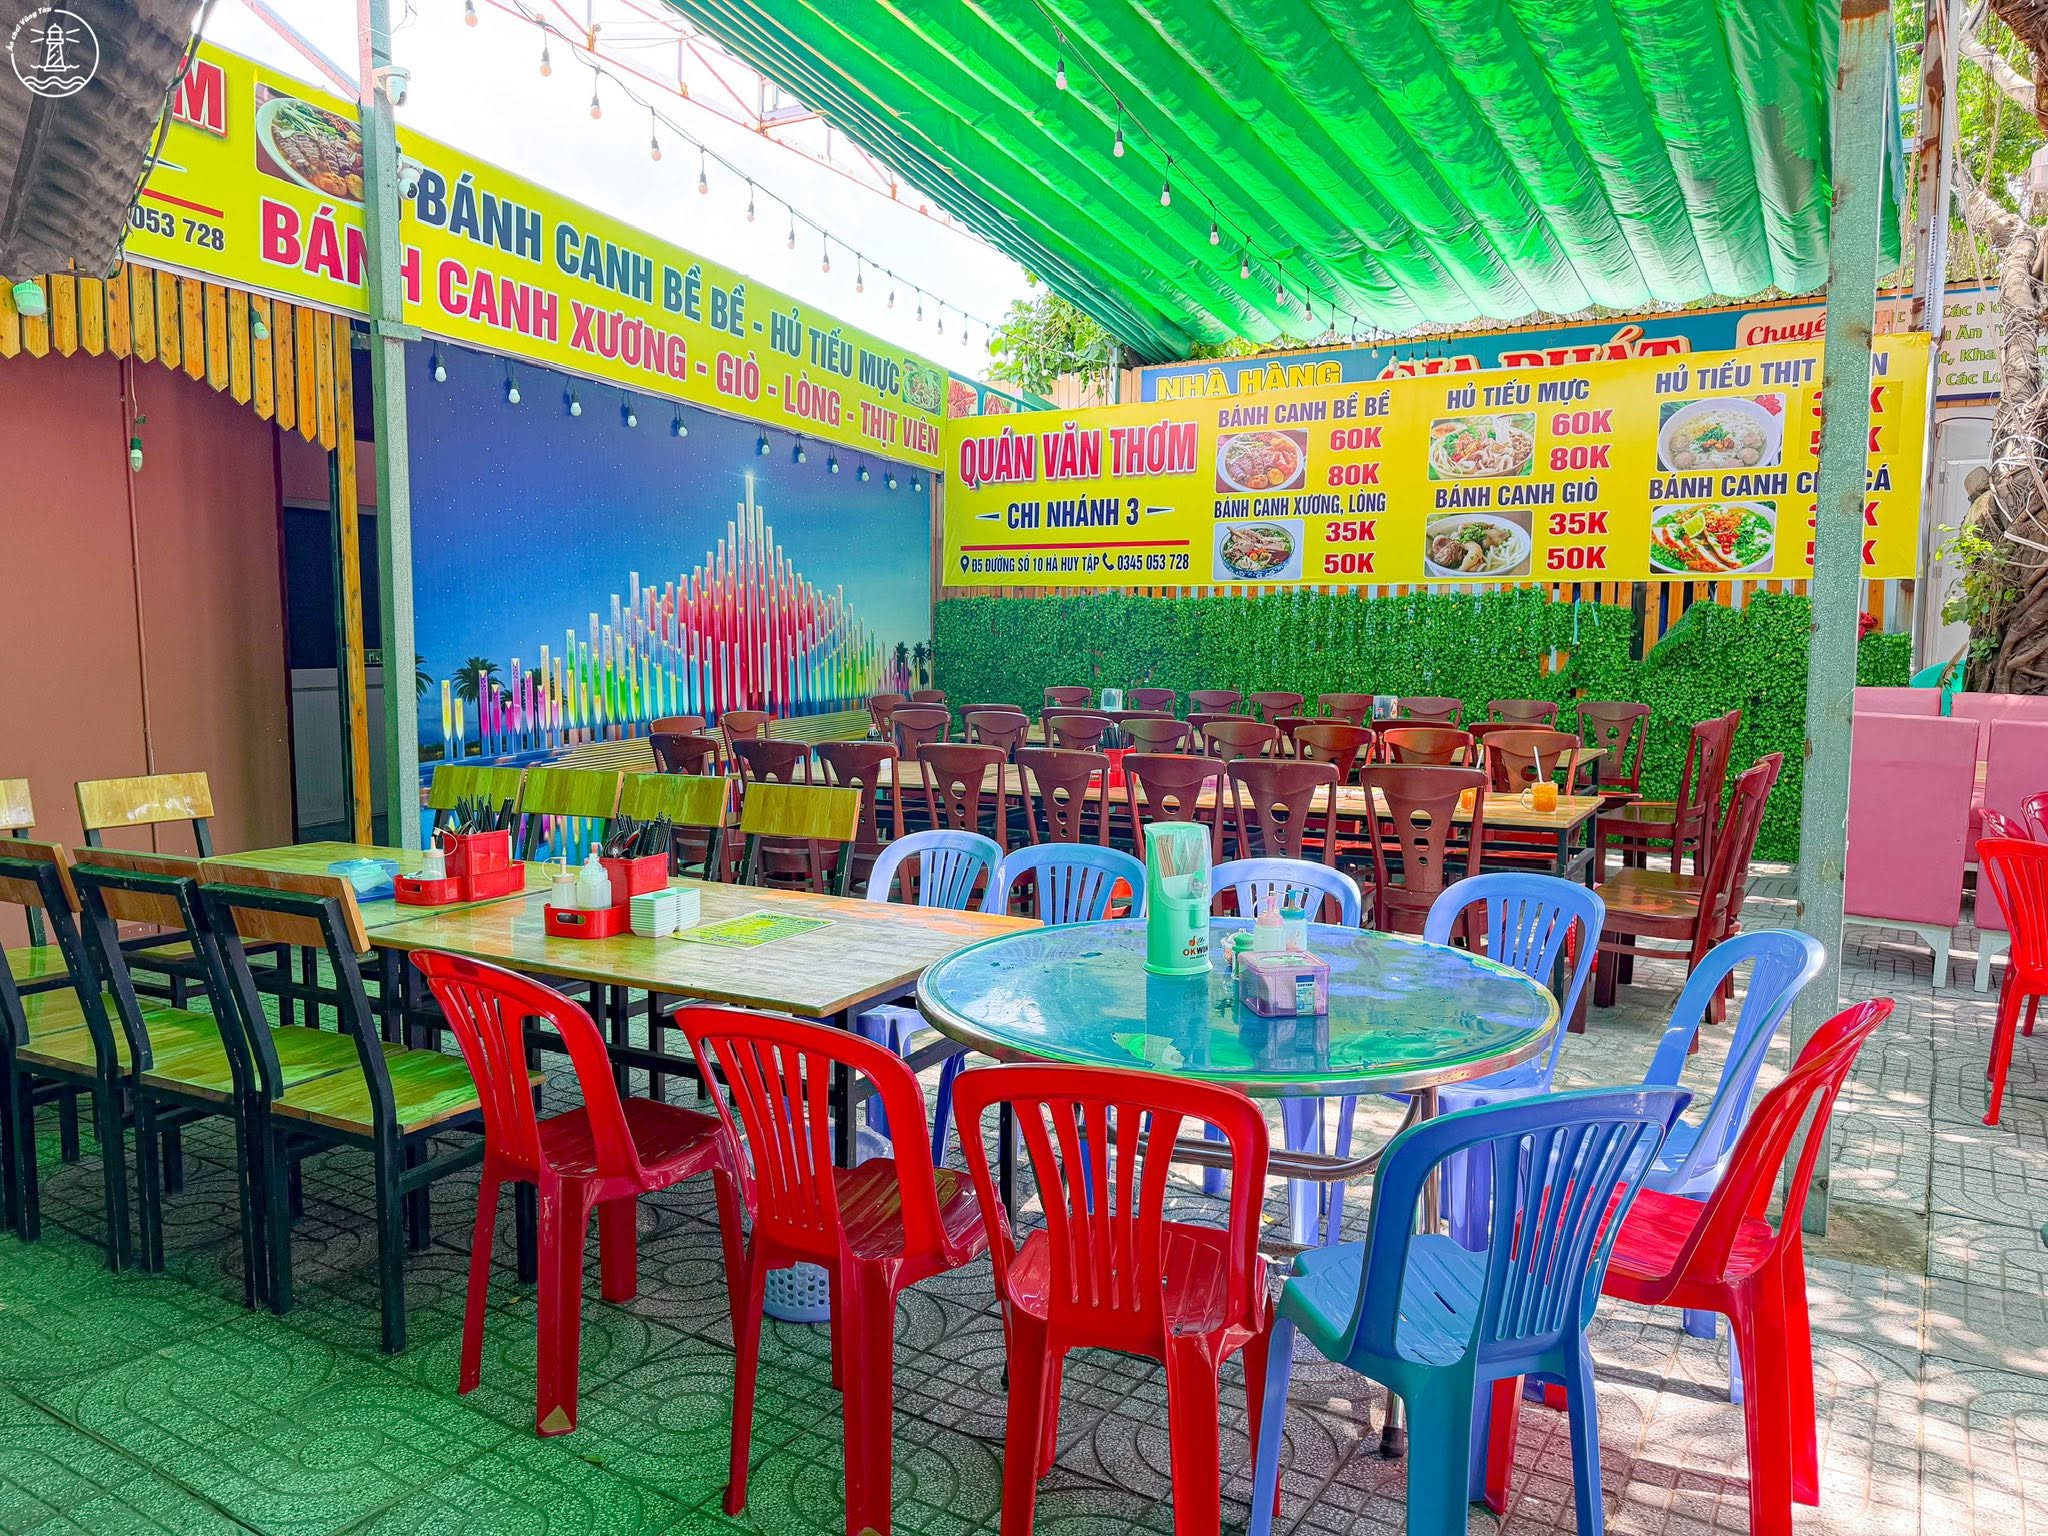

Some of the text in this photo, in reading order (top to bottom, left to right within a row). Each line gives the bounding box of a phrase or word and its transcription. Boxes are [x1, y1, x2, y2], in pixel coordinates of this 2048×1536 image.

[131, 205, 225, 251] 053 728
[416, 168, 541, 262] BÁNH
[556, 225, 652, 303] CANH
[664, 264, 702, 323] BỀ
[711, 285, 745, 337] BỀ
[770, 308, 800, 358] HỦ
[809, 328, 853, 378] TIẾU
[859, 349, 900, 397] MỰC
[1747, 311, 1826, 346] Chuyê
[439, 259, 558, 342] CANH
[571, 299, 687, 381] XƯƠNG
[716, 351, 760, 402] GIÒ
[783, 373, 840, 427] LÒNG
[860, 400, 897, 445] THỊT
[903, 413, 939, 455] VIÊN
[1960, 347, 1997, 362] Kha
[1158, 362, 1342, 400] NHÀ HÀNG
[1655, 358, 1816, 394] HỦ TIẾU THỊT
[1218, 388, 1391, 428] BÁNH CANH BỀ BỀ
[1447, 378, 1590, 410] HỦ TIẾU MỰC
[1552, 409, 1613, 436] 60K
[1330, 426, 1383, 451] 60K
[959, 418, 1199, 490] QUÁN VĂN THƠM
[1549, 444, 1611, 471] 80K
[1328, 462, 1381, 488] 80K
[1649, 473, 1713, 500] BÁNH
[1721, 472, 1787, 497] CANH
[1214, 488, 1386, 520] BÁNH CANH XƯƠNG, LÒNG
[1435, 477, 1599, 509] BÁNH CANH GIÒ
[1007, 493, 1139, 530] CHI NHÁNH 3
[1548, 510, 1609, 536] 35K
[1325, 520, 1376, 543] 35K
[985, 555, 1015, 573] ĐƯỜNG
[1018, 552, 1031, 572] SỐ
[1033, 557, 1043, 572] 10
[1046, 554, 1058, 571] HÀ
[1061, 556, 1079, 571] HUY
[1082, 553, 1100, 575] TẬP
[1117, 553, 1190, 571] 0345 053 728
[1323, 552, 1376, 575] 50K
[1546, 545, 1607, 571] 50K
